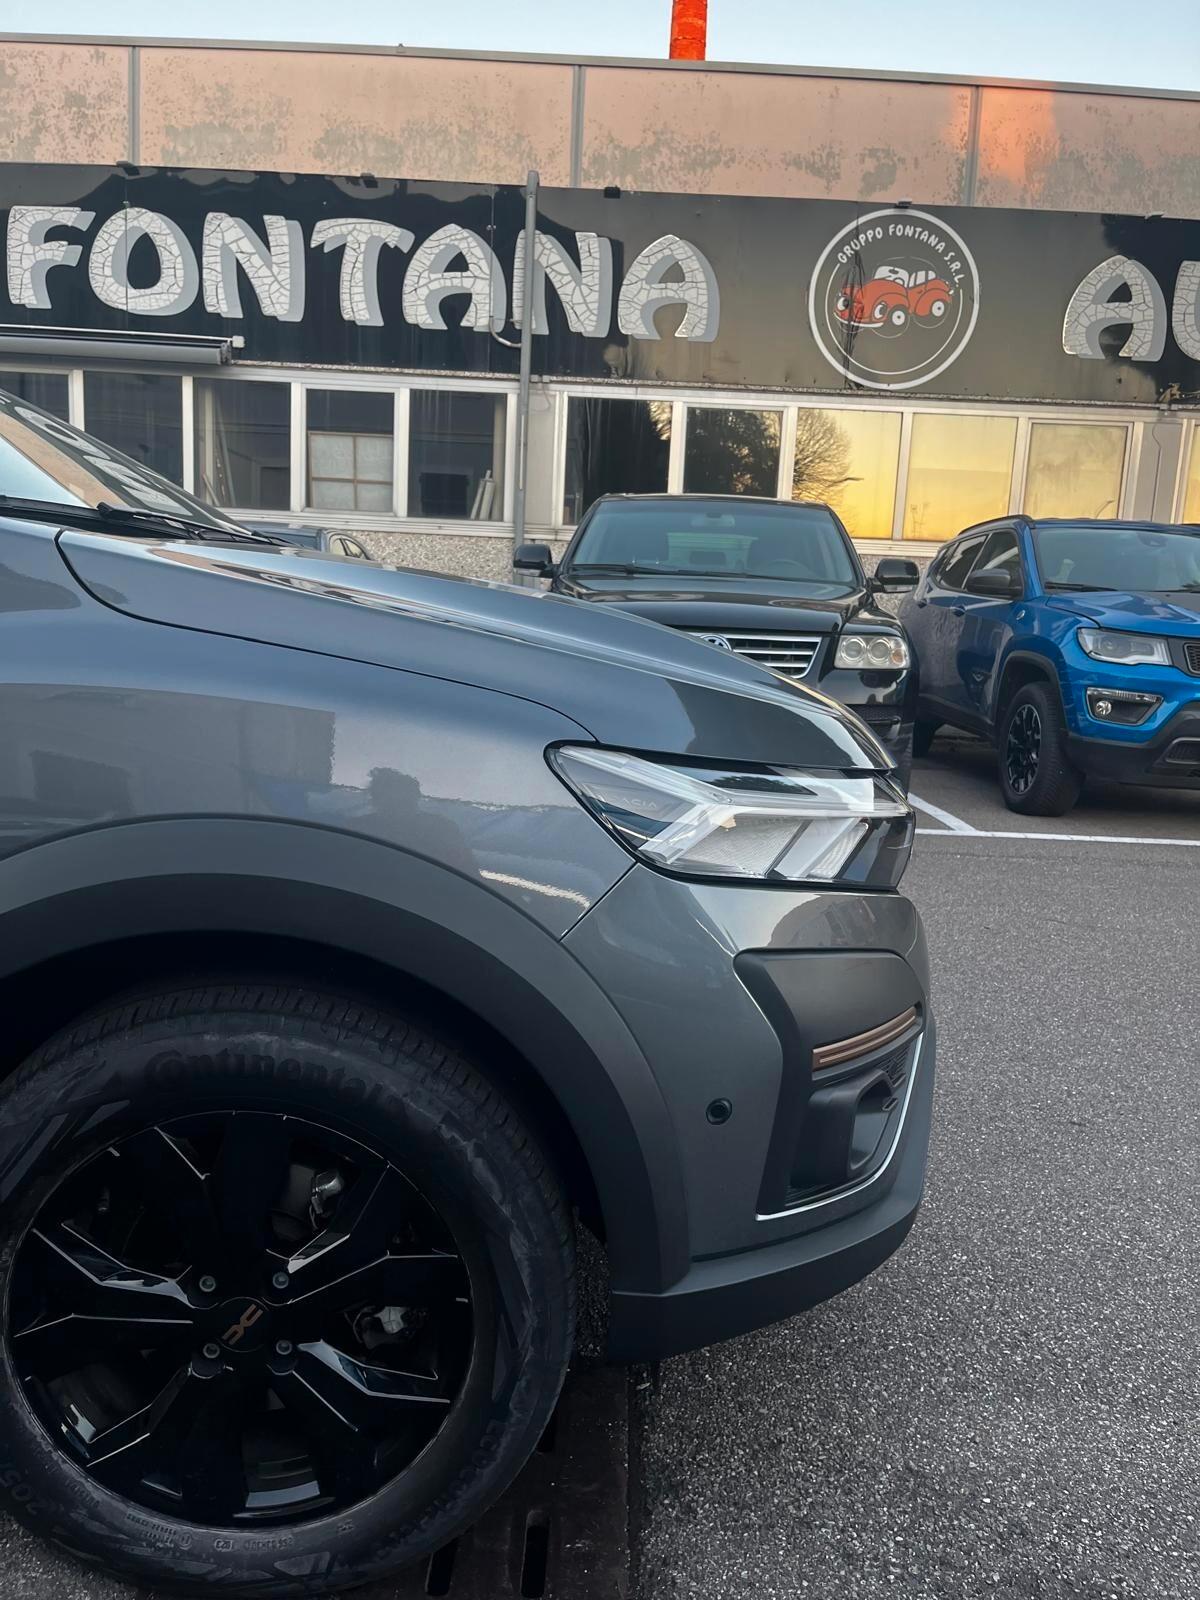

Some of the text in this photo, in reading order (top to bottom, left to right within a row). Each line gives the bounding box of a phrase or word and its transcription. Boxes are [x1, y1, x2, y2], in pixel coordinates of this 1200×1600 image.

[7, 205, 719, 342] FONTANA
[838, 223, 966, 288] GRUPPO FONTANA S.R.L.
